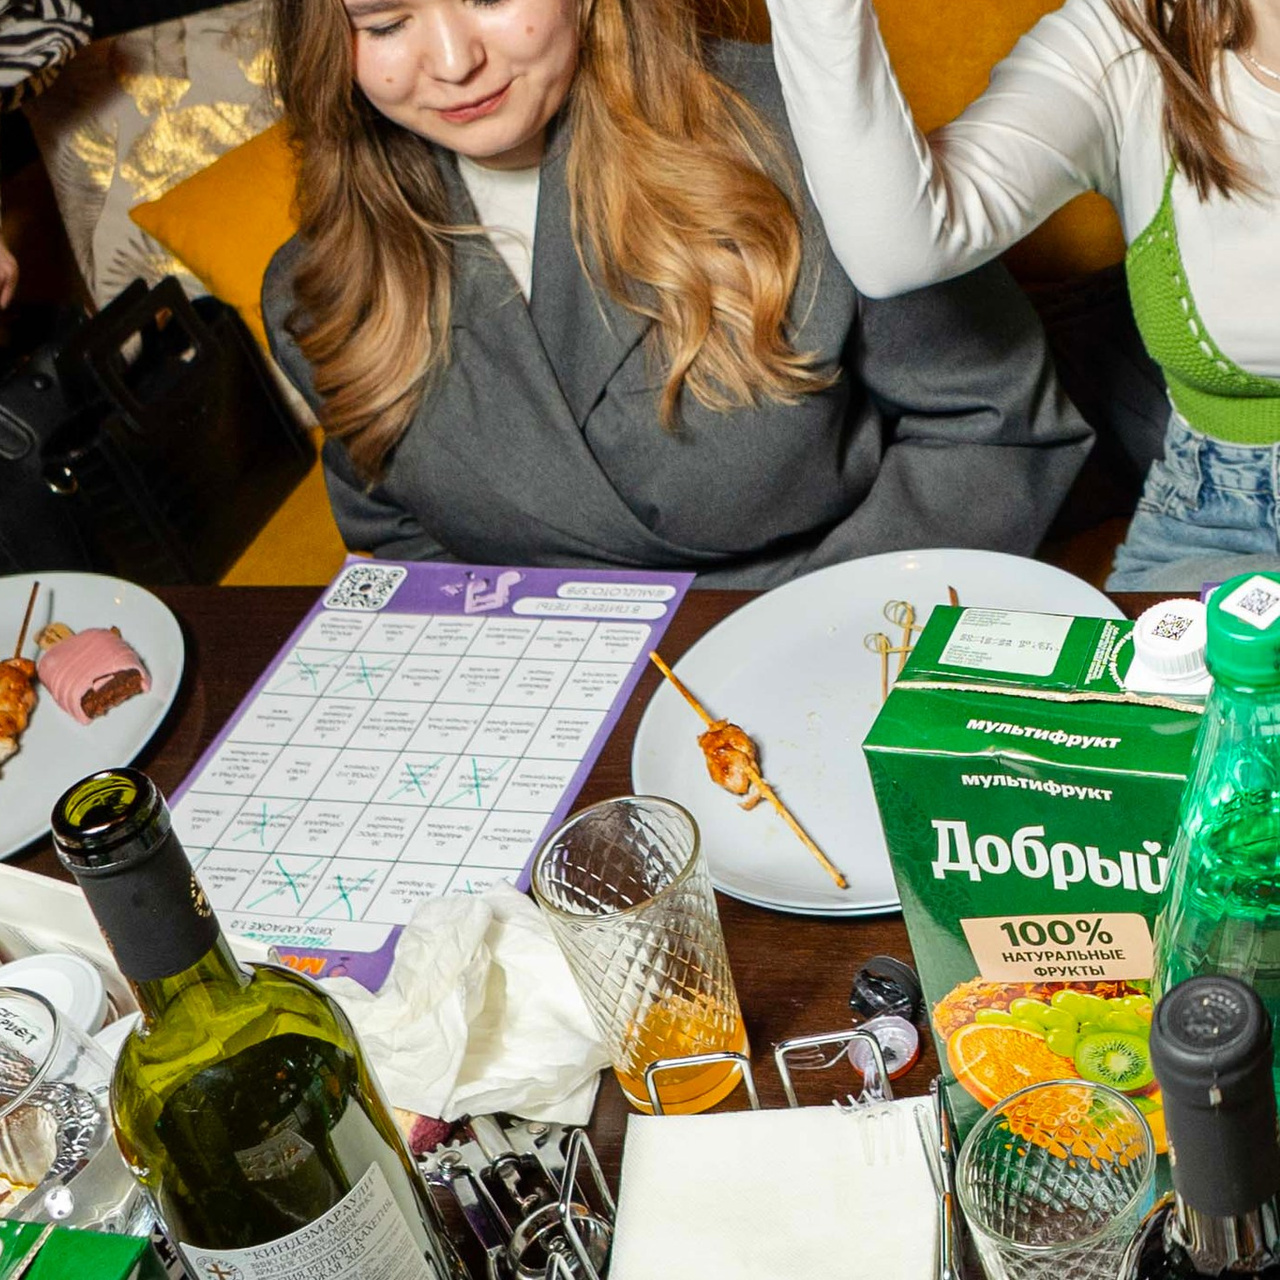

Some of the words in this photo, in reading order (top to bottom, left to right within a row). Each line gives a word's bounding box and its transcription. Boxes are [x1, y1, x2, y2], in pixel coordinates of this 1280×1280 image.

[582, 604, 630, 613] ПИТЕРЕ
[966, 718, 1122, 749] мультифрукт
[961, 774, 1113, 802] мультифрукт
[931, 818, 1169, 894] Добрый
[247, 923, 303, 935] КАРАОКЕ
[304, 927, 335, 936] ХИТЫ
[1000, 918, 1114, 947] 100%
[1002, 950, 1126, 963] НАТУРАЛЬНЫЕ
[1034, 965, 1105, 977] ФРУКТЫ
[307, 1242, 353, 1276] РЕГИОН
